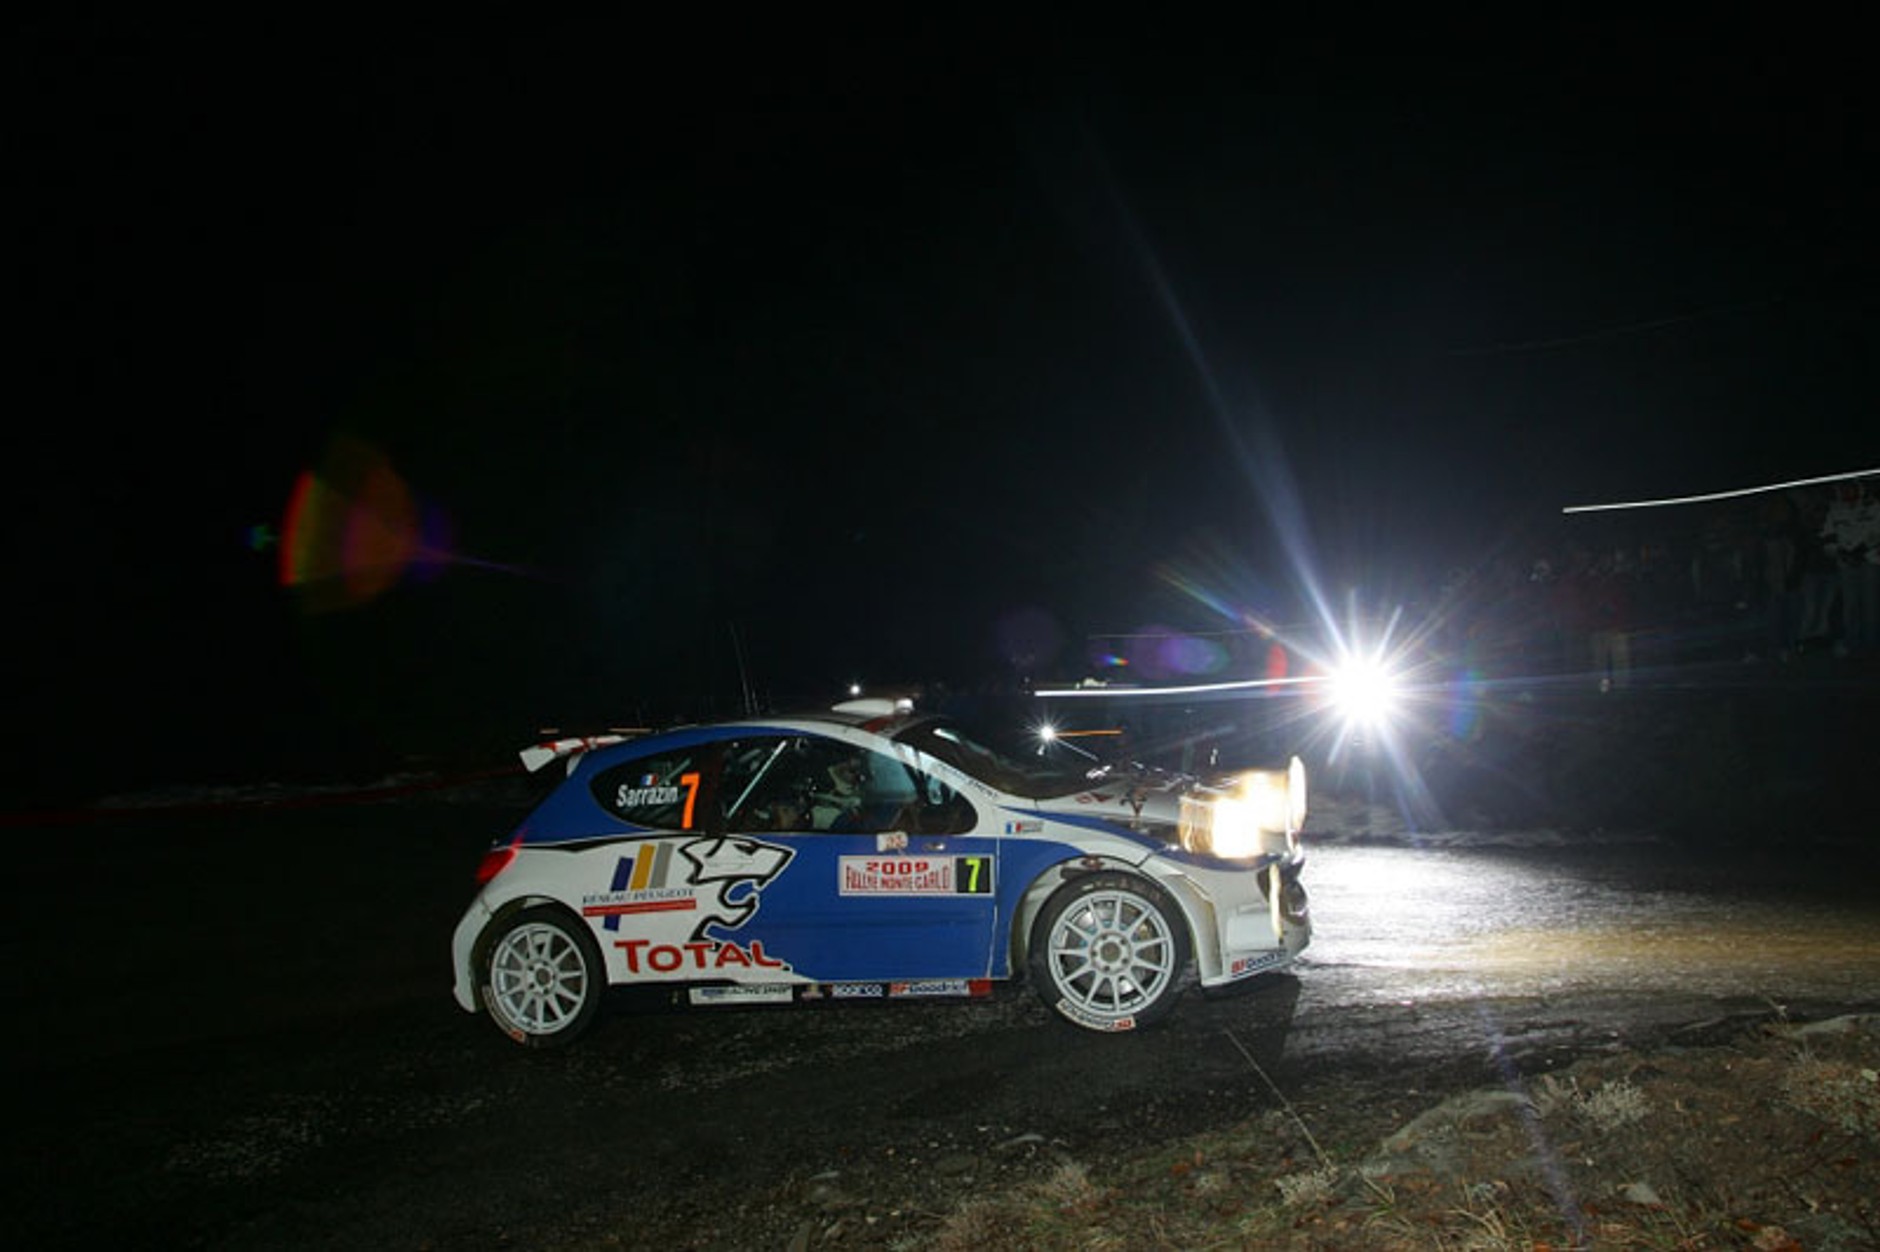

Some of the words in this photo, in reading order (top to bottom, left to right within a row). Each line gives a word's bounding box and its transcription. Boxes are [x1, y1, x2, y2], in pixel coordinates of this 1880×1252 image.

[616, 784, 678, 807] Sarrazin
[680, 773, 700, 830] 7
[846, 865, 877, 889] RALLYE
[881, 878, 912, 889] MONTE
[914, 865, 950, 889] CARLO
[866, 861, 929, 875] 2009
[965, 858, 981, 892] 7
[634, 888, 694, 900] PEUGEOT
